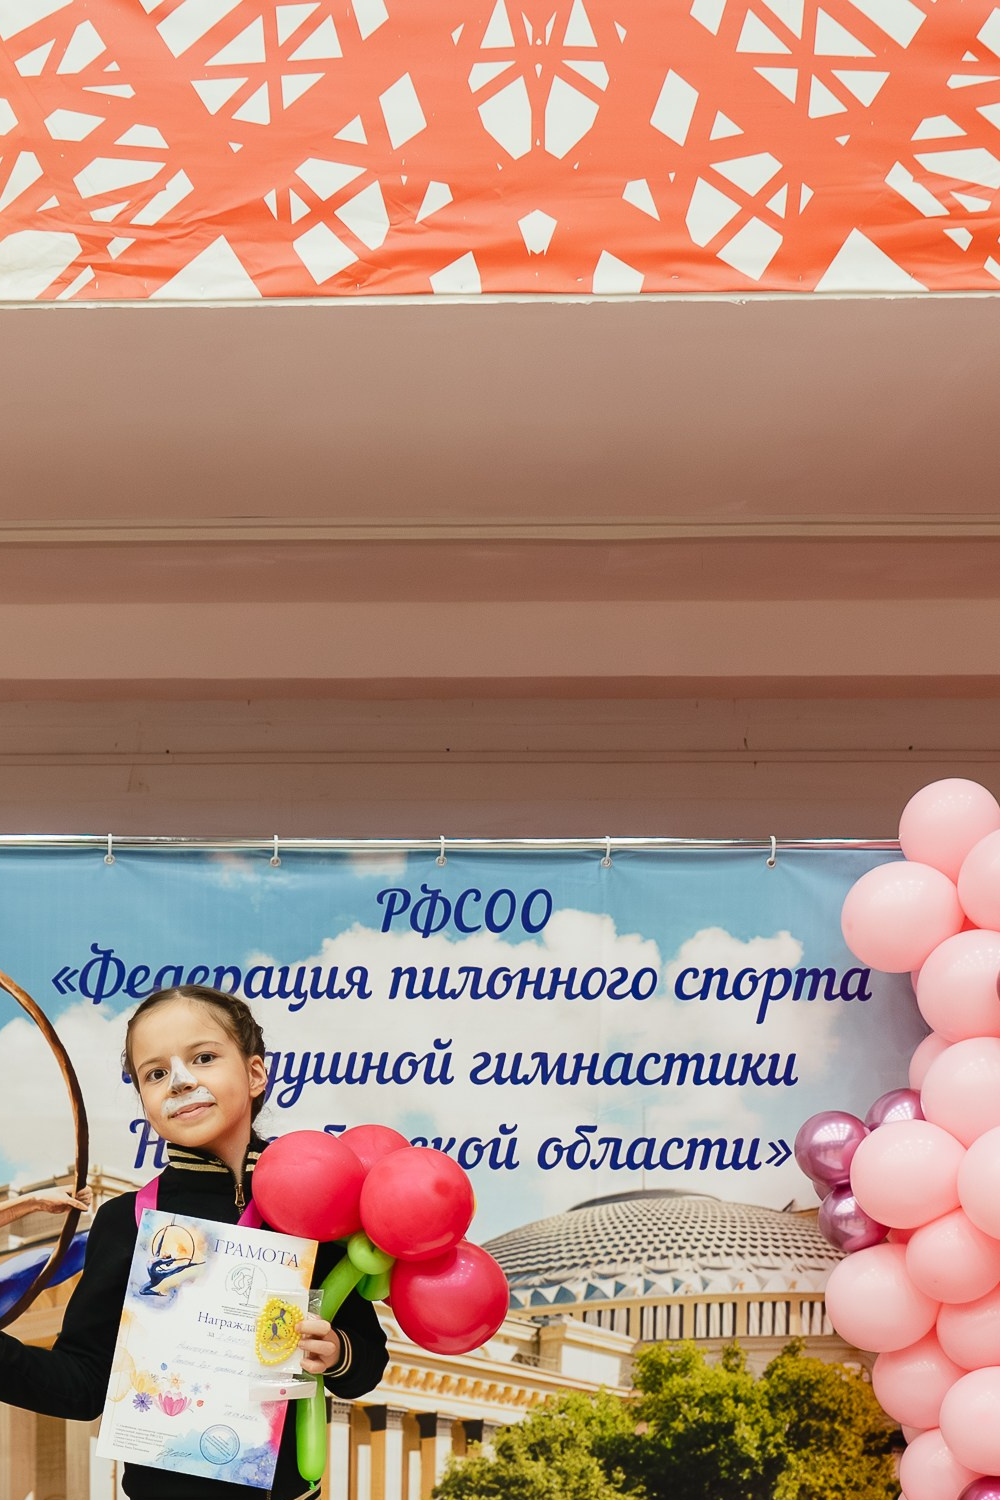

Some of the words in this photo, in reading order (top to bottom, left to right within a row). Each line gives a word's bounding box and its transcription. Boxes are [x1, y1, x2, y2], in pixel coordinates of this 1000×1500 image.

[376, 883, 554, 939] РФСОО
[388, 964, 658, 1002] пилонного
[674, 964, 872, 1025] спорта
[263, 1038, 455, 1109] душной
[469, 1050, 799, 1087] гимнастики
[537, 1123, 792, 1171] области»
[214, 1238, 299, 1268] ГРАМОТА
[197, 1311, 257, 1333] Награжда
